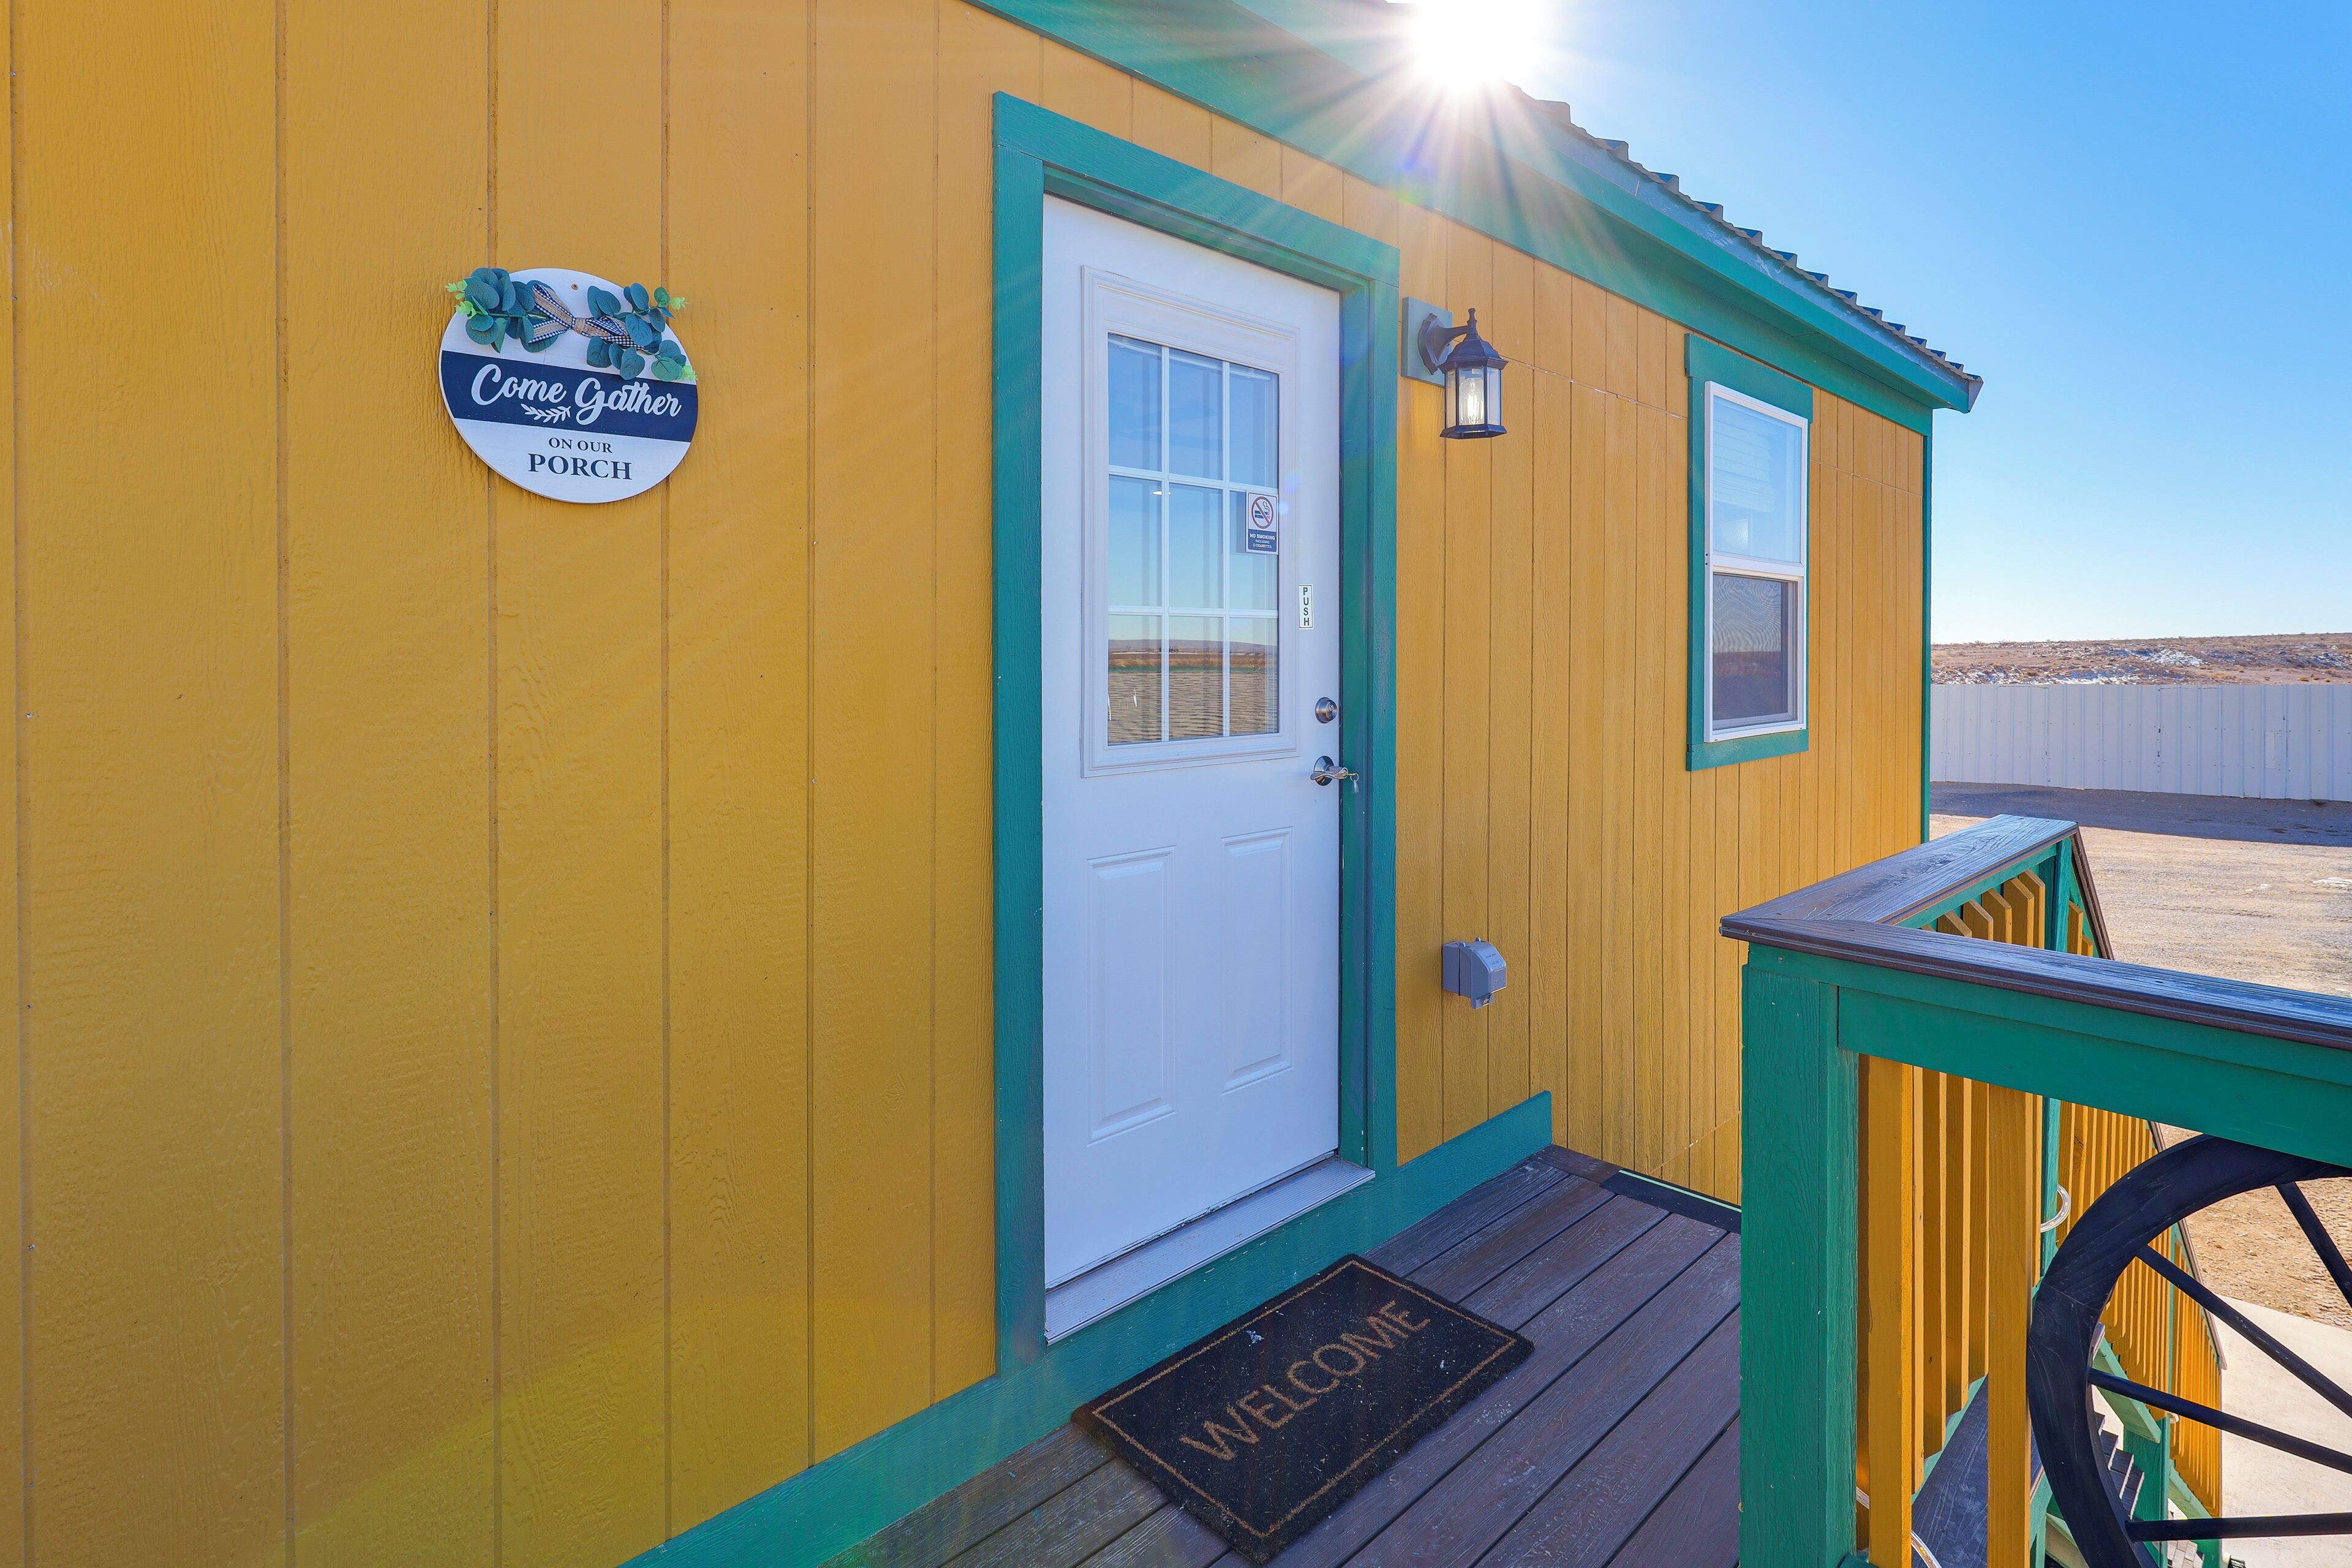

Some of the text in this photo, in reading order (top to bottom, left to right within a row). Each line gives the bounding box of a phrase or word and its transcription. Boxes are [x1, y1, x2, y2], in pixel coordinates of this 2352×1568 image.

[471, 364, 682, 425] Come Gather
[527, 453, 632, 480] PORCH
[549, 437, 612, 453] ON OUR
[1180, 1299, 1431, 1461] WELCOME
